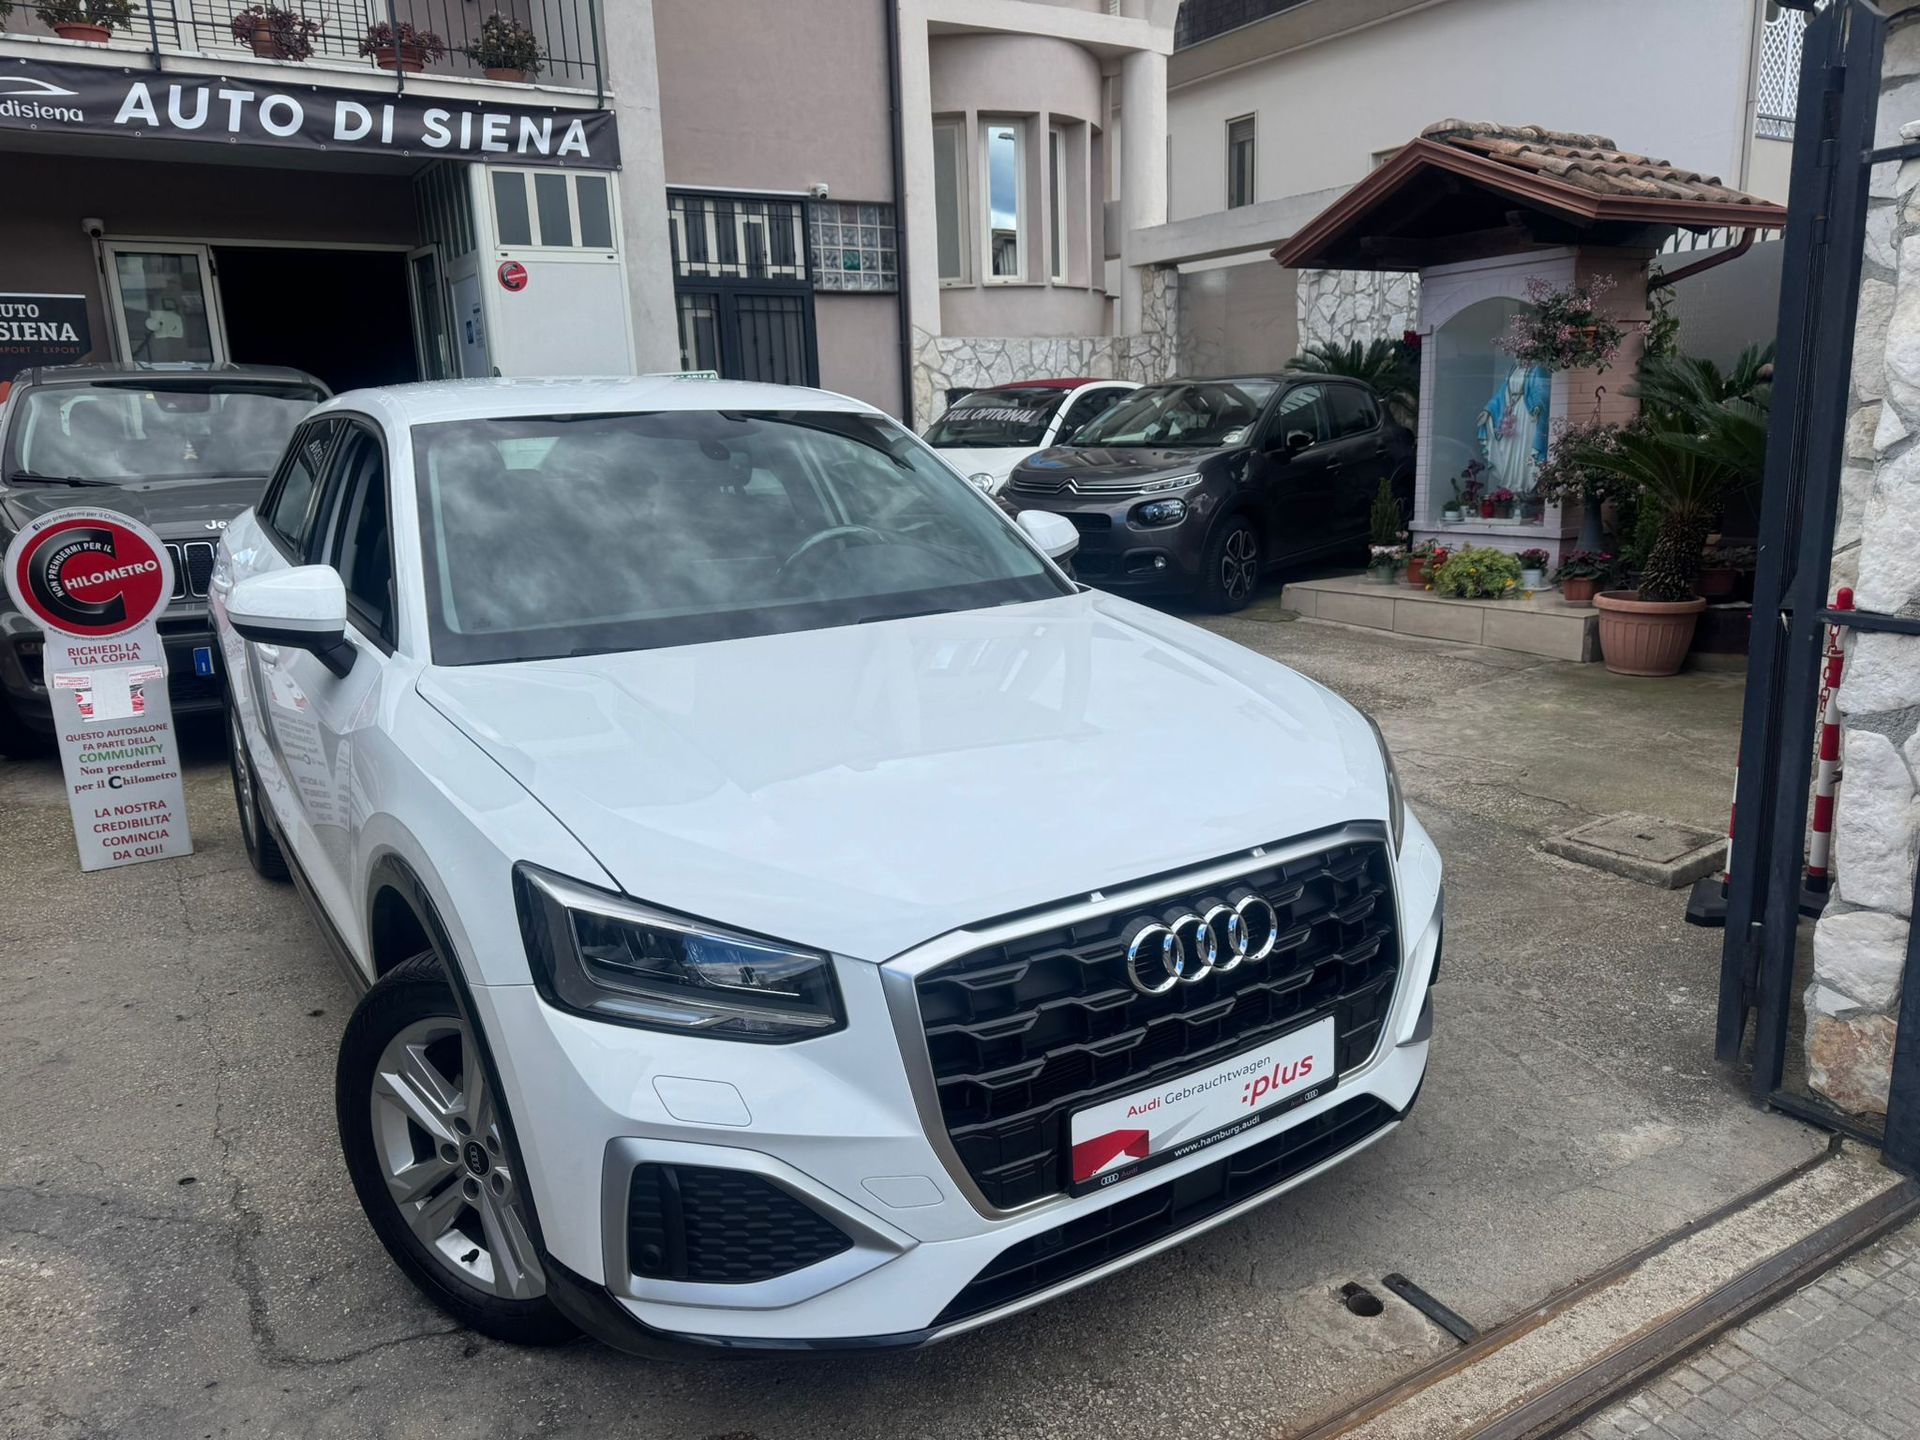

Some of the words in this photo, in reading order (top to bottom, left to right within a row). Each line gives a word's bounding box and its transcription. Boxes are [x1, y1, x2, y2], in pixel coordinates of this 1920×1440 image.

[113, 82, 304, 137] AUTO
[333, 100, 394, 144] DI
[421, 108, 590, 158] SIENA
[0, 304, 39, 318] UTO
[43, 346, 80, 354] EXPORT
[942, 408, 975, 422] FULL
[970, 407, 1036, 423] OPTIONAL
[52, 511, 85, 522] prendermi
[86, 511, 97, 519] per
[204, 519, 230, 530] Je
[83, 542, 101, 551] PER
[103, 544, 112, 553] IL
[48, 544, 82, 580] PRENDERMI
[50, 581, 65, 598] NON
[67, 643, 122, 657] RICHIEDI
[125, 642, 141, 652] LA
[71, 655, 98, 666] TUA
[101, 652, 140, 663] COPIA
[65, 731, 105, 742] QUESTO
[106, 722, 169, 738] AUTOSALONE
[82, 743, 95, 752] FA
[96, 740, 126, 750] PARTE
[128, 735, 156, 746] DELLA
[78, 744, 164, 764] COMMUNITY
[80, 766, 104, 776] Non
[107, 756, 166, 775] prendermi
[74, 783, 94, 794] per
[96, 780, 106, 789] il
[108, 771, 178, 790] Chilometro
[94, 807, 112, 819] LA
[114, 799, 167, 816] NOSTRA
[102, 829, 170, 848] COMINCIA
[113, 849, 133, 861] DA
[134, 844, 164, 858] QUI!
[1126, 1096, 1161, 1118] Audi
[1164, 1056, 1271, 1105] Gebrauchtwagen
[1241, 1055, 1314, 1107] :plus
[1173, 1114, 1261, 1158] www.hamburg.audi
